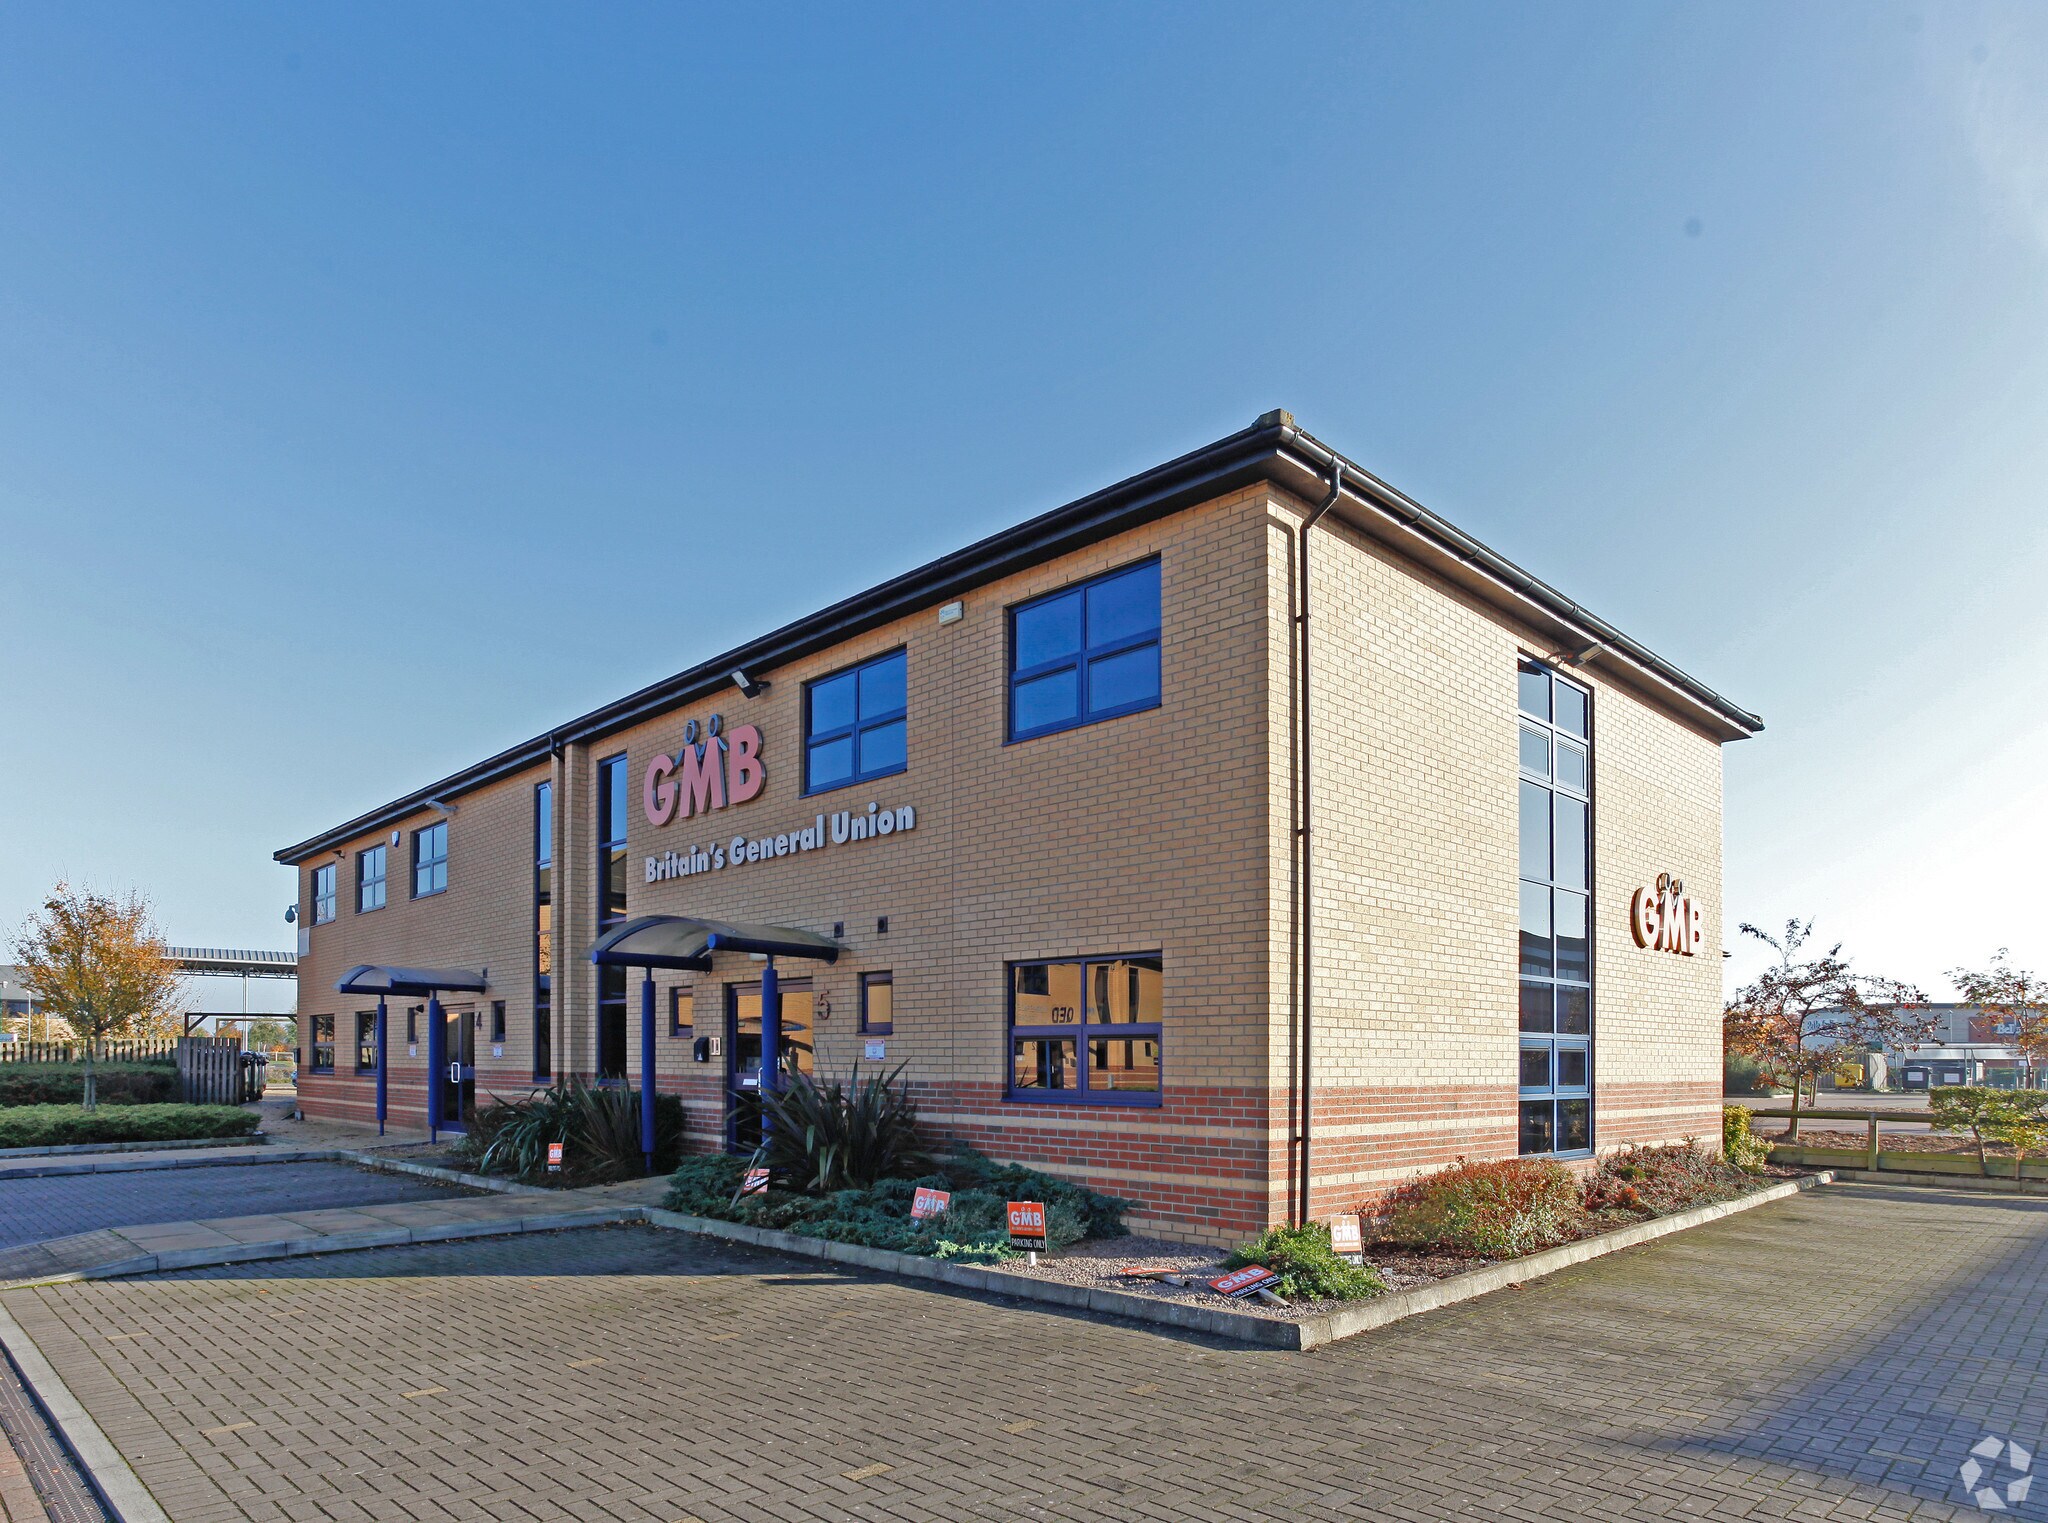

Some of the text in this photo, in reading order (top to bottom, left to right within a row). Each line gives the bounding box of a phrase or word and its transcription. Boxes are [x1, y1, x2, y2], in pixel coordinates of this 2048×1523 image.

[643, 722, 767, 826] GMB
[645, 802, 916, 883] Britain's General Union
[1632, 882, 1706, 956] GMB
[817, 989, 831, 1021] 5
[475, 1011, 483, 1031] 4
[1010, 1209, 1043, 1227] GMB
[1011, 1237, 1045, 1249] PARKING ONLY
[1333, 1223, 1359, 1242] GMB
[1217, 1268, 1265, 1289] GMB
[1230, 1281, 1263, 1298] PARKING
[1261, 1274, 1280, 1284] ONLY
